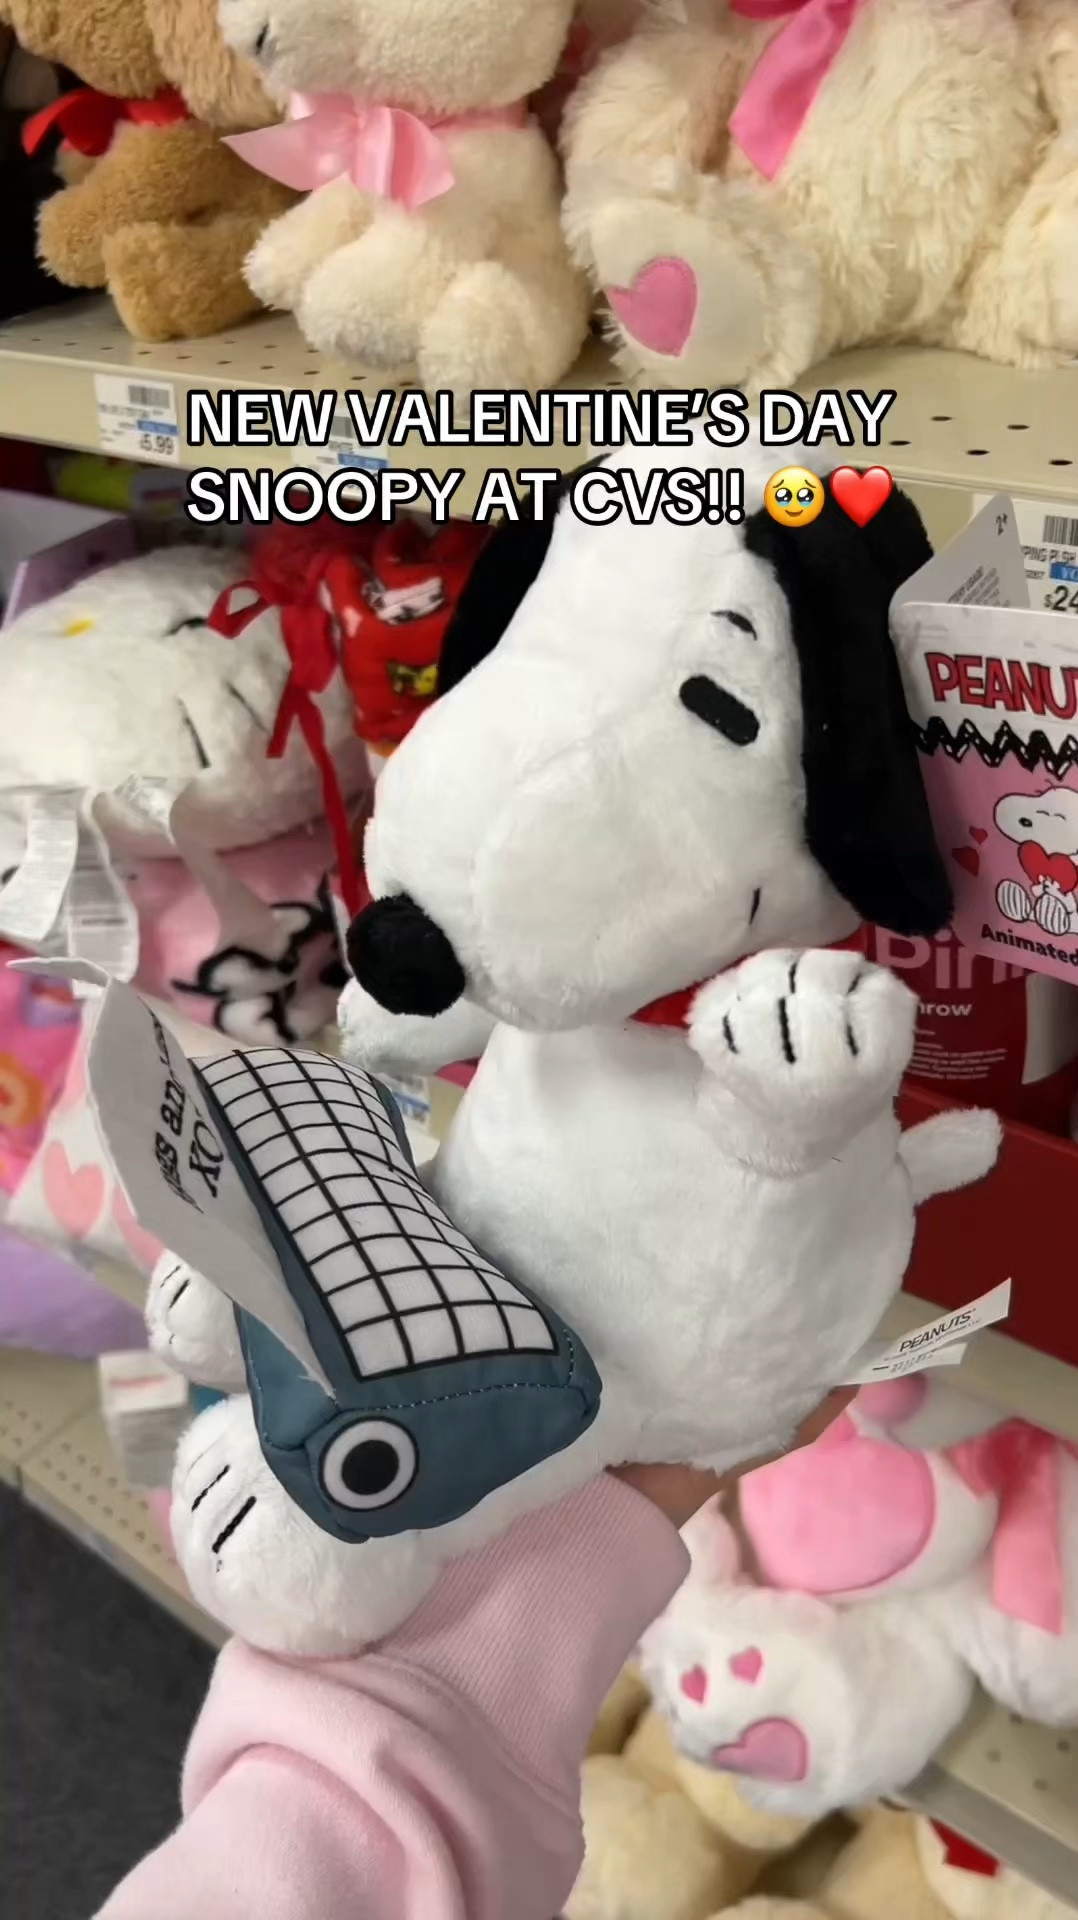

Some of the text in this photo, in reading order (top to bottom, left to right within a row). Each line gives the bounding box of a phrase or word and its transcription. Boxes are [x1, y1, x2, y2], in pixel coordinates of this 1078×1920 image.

[924, 652, 1078, 720] PEANU
[982, 924, 1078, 967] Animated
[900, 1310, 974, 1353] PEANUTS
